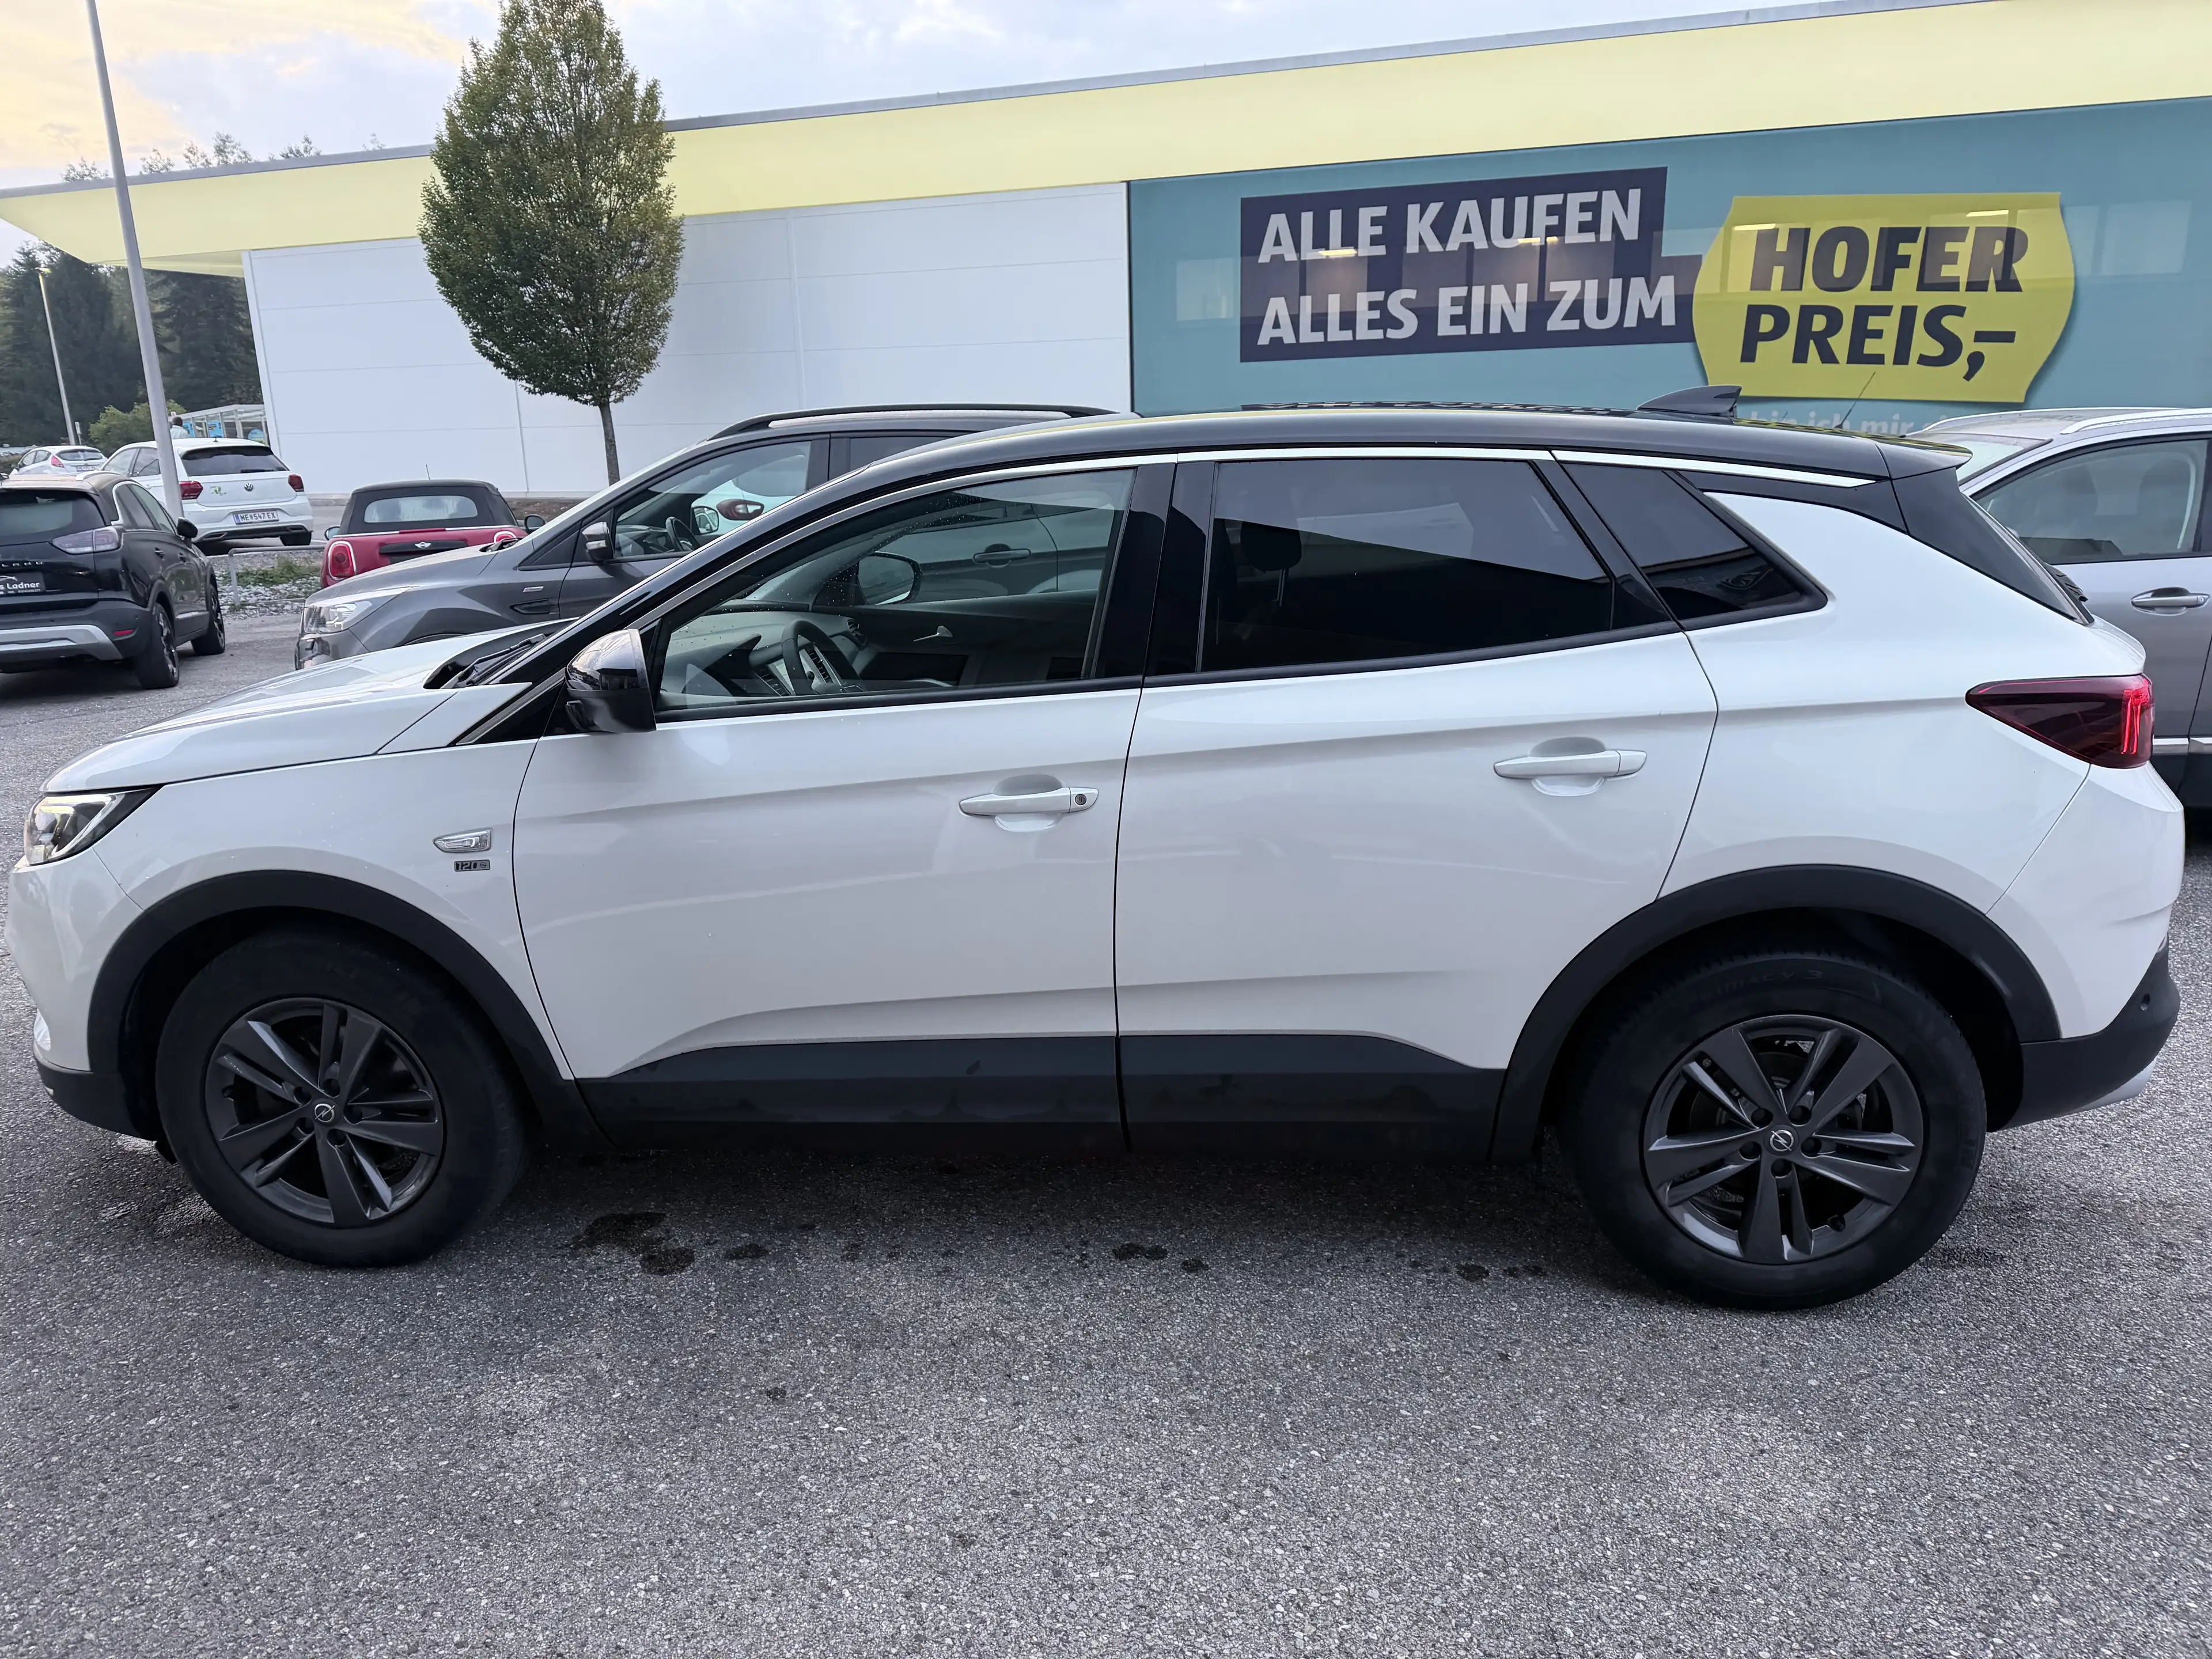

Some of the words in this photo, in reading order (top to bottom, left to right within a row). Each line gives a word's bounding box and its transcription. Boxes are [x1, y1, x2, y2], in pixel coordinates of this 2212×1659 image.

[1257, 206, 1388, 263] ALLE
[1406, 188, 1641, 253] KAUFEN
[1751, 226, 2028, 293] HOFER
[1257, 289, 1418, 345] ALLES
[1437, 283, 1528, 336] EIN
[1547, 275, 1675, 331] ZUM
[1860, 413, 1914, 435] mir
[253, 512, 266, 520] 547
[1804, 969, 1823, 980] 3
